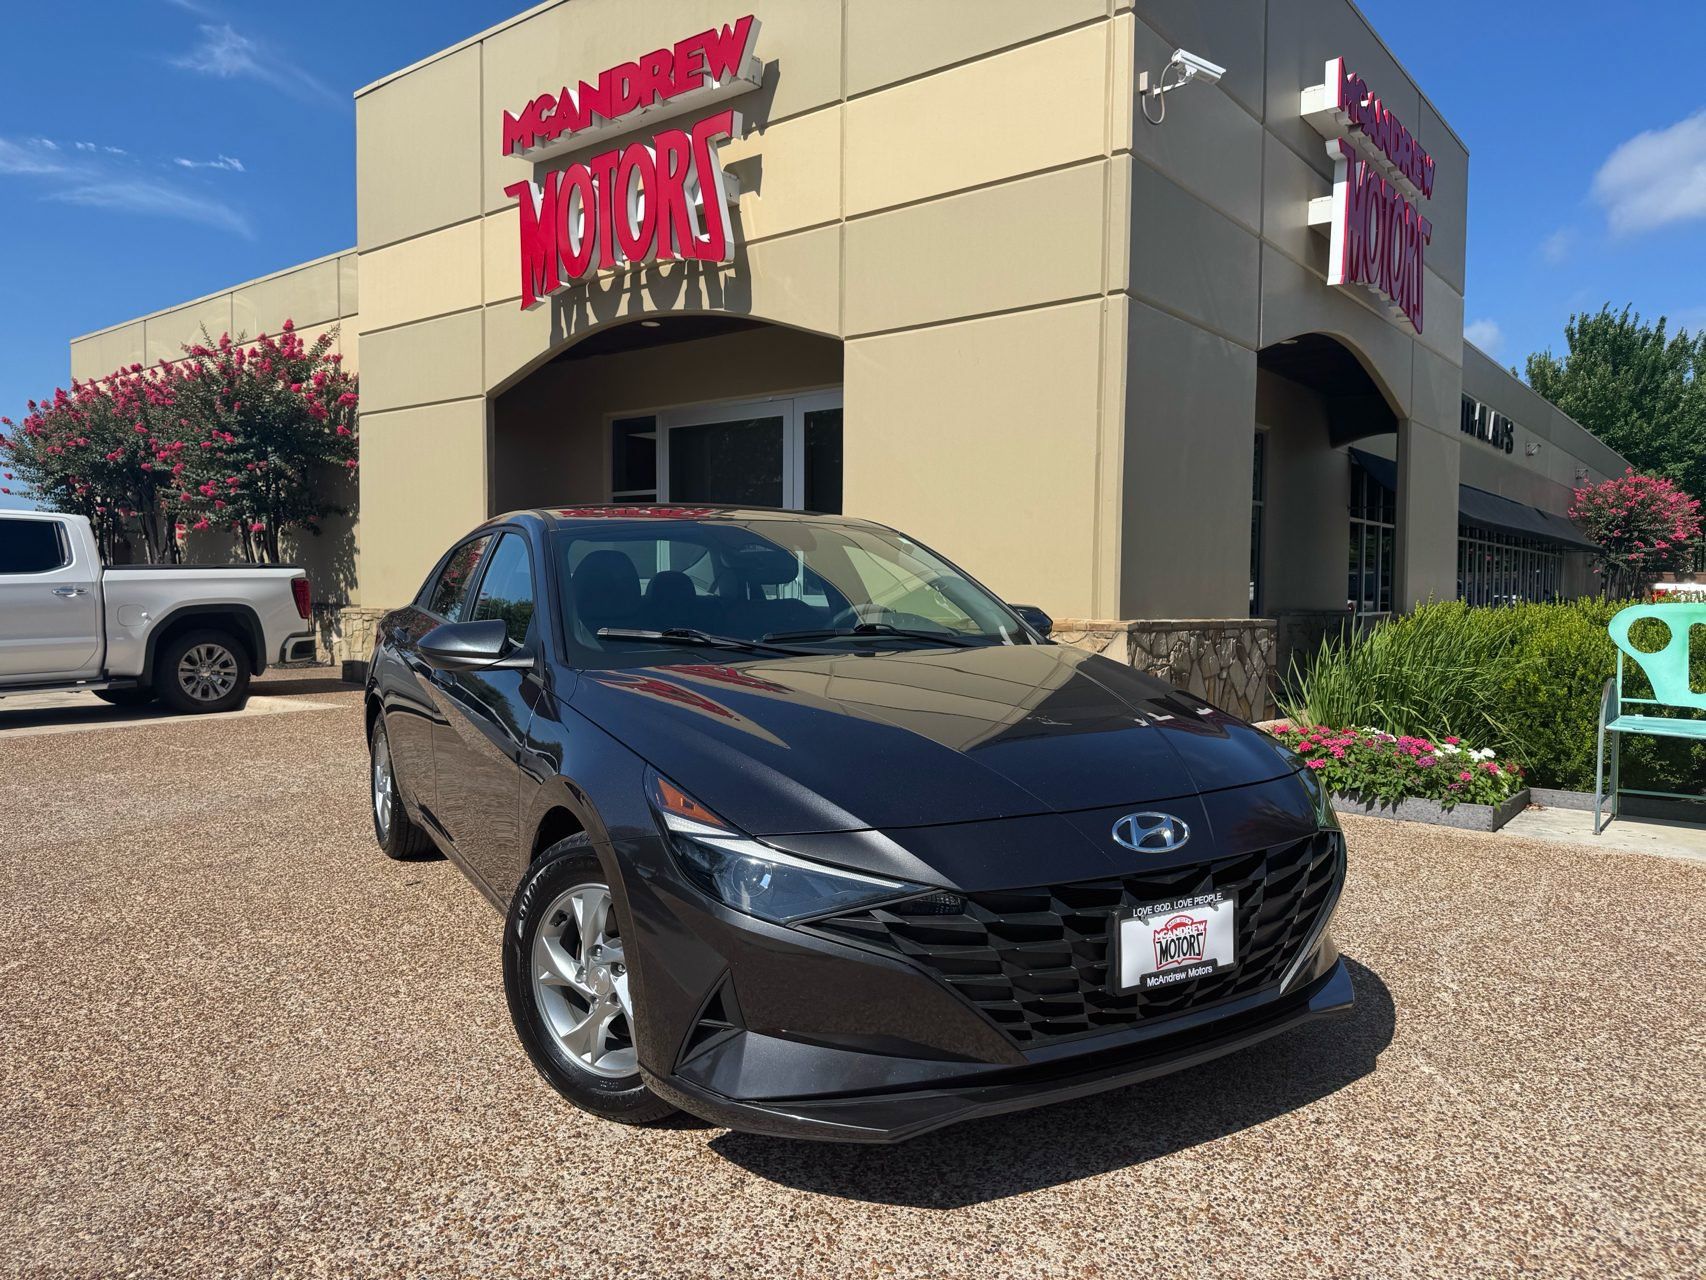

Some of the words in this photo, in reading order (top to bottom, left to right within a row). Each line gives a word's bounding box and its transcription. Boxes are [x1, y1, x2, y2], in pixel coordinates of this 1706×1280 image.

[504, 109, 734, 311] MOTORS
[1338, 137, 1433, 335] MOTORS
[1133, 906, 1152, 917] LOVE
[1154, 902, 1172, 913] GOD.
[1174, 898, 1193, 909] LOVE
[1194, 893, 1223, 906] PEOPLE.
[1156, 933, 1203, 964] MOTORS
[1147, 972, 1186, 987] McAndrew
[1188, 965, 1213, 978] Motors
